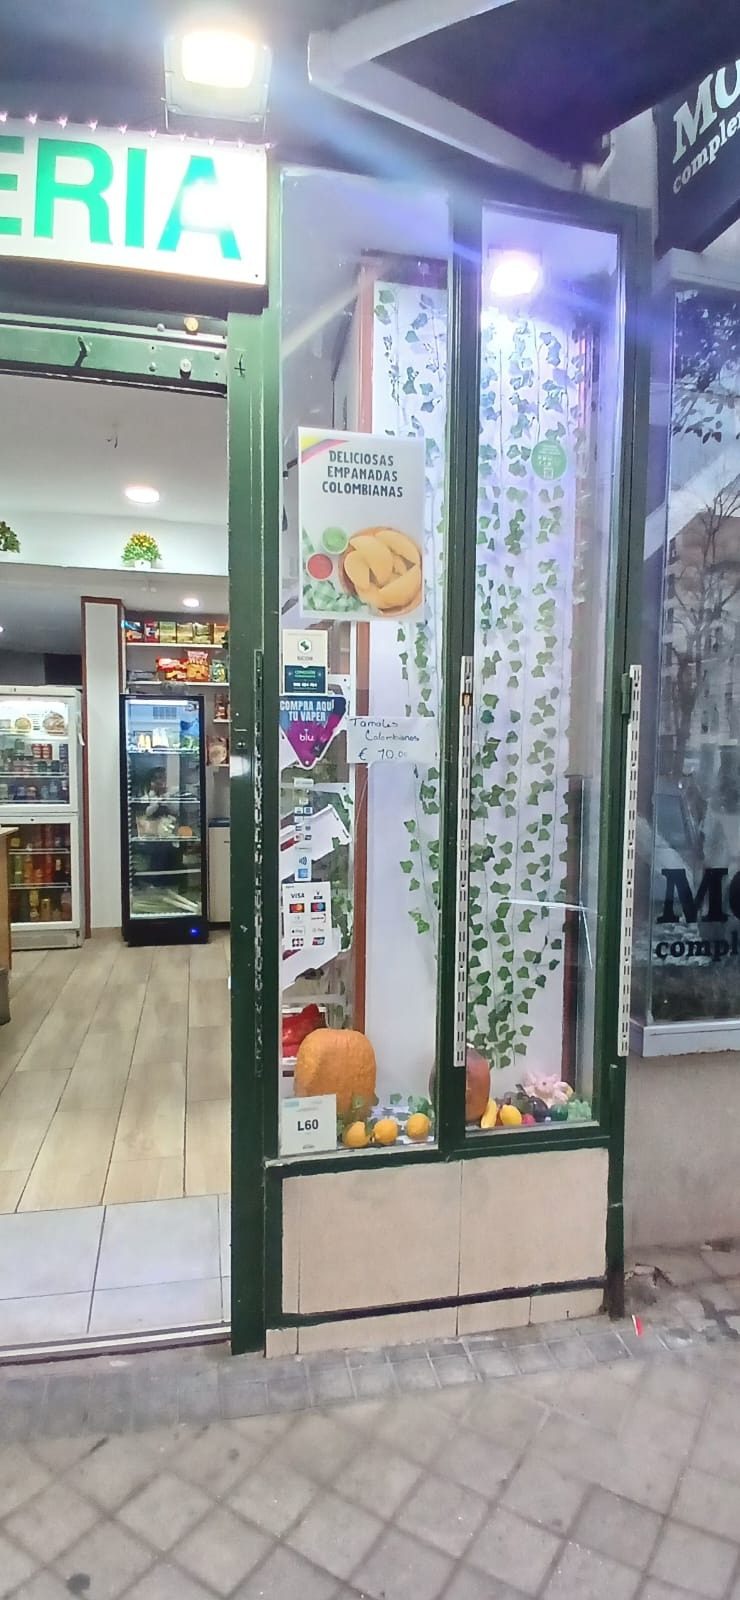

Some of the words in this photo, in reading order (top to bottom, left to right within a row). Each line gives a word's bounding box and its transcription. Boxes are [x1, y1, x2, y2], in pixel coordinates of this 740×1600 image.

[329, 450, 394, 467] DELICIOSAS
[327, 466, 398, 482] EMPANADAS
[322, 481, 404, 498] COLOMBIANAS
[280, 700, 314, 711] COMPRA
[316, 699, 335, 711] AQUÍ
[289, 711, 298, 722] TU
[300, 712, 326, 722] VAPER
[656, 868, 740, 924] M
[297, 1118, 319, 1131] L60
